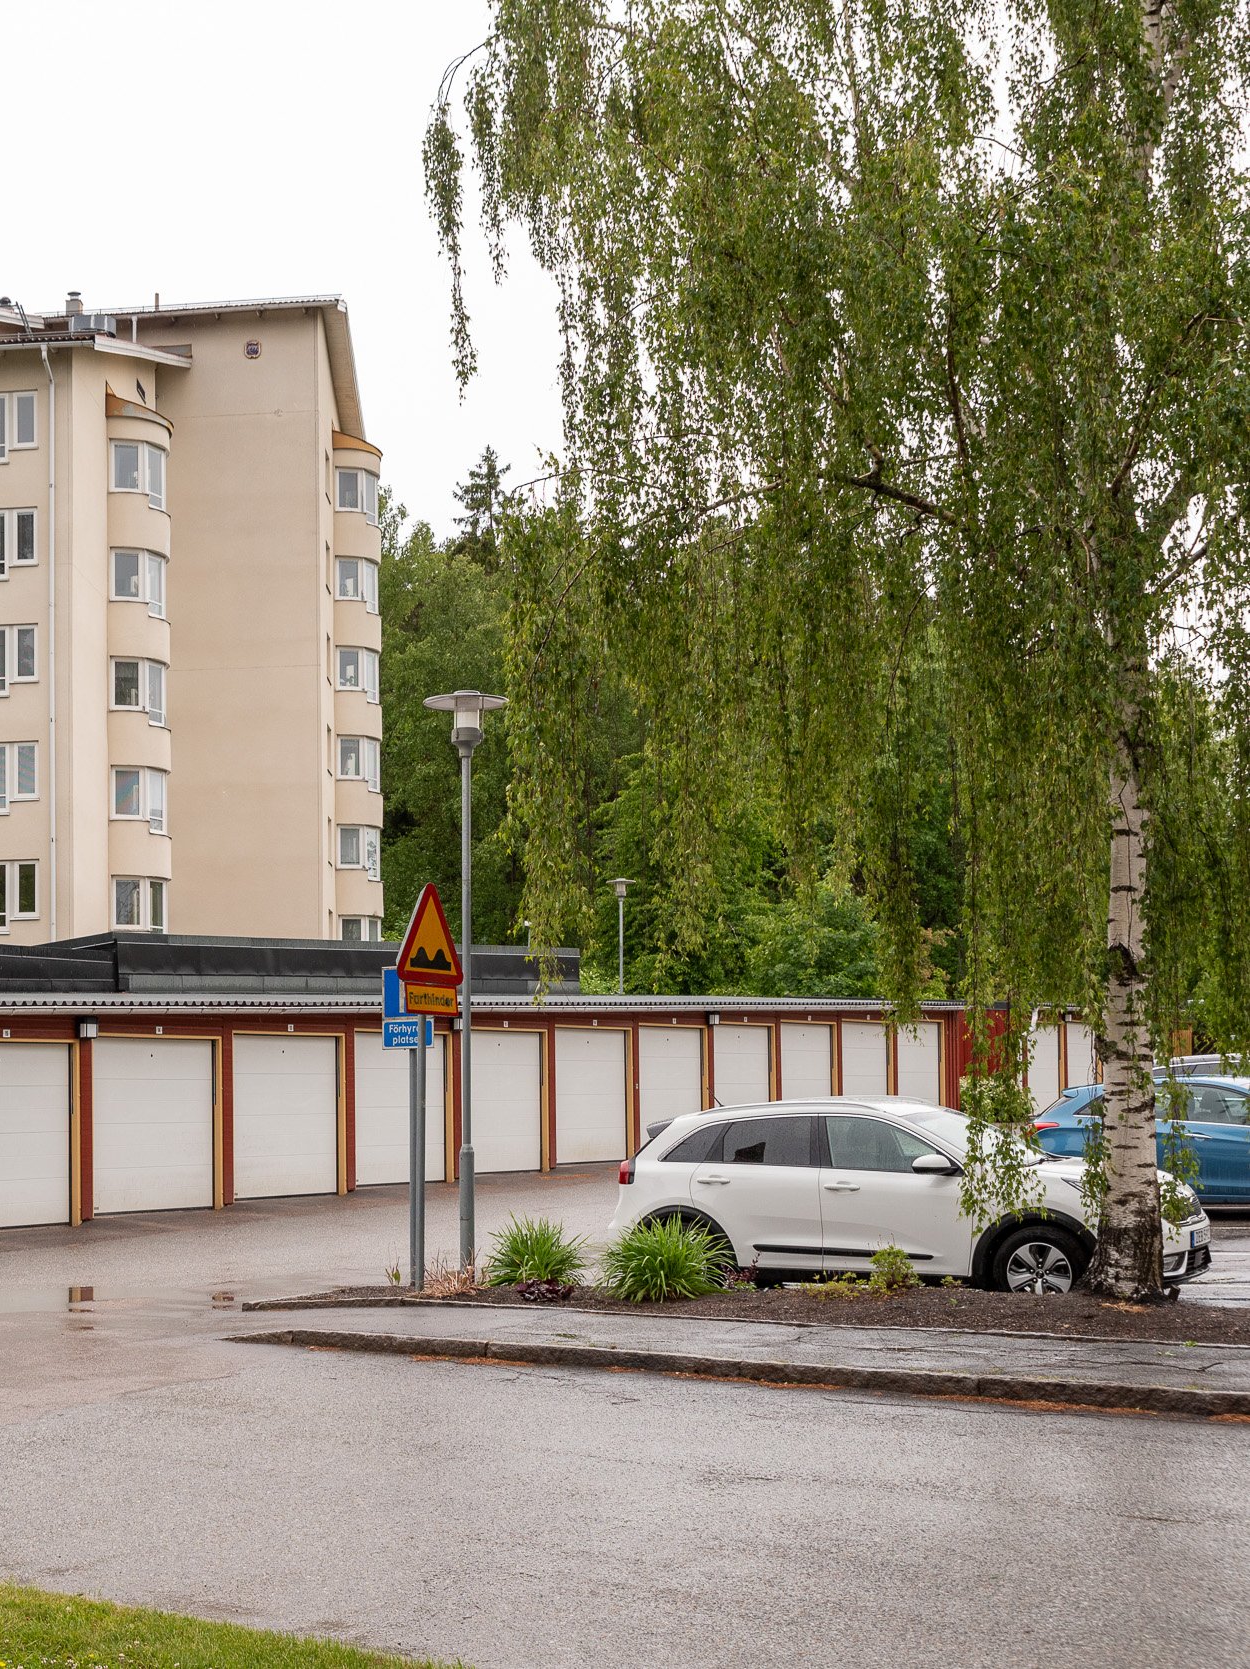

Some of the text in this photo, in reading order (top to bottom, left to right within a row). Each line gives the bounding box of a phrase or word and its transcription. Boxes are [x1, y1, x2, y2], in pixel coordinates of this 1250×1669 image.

[409, 992, 454, 1007] Farthinder
[389, 1023, 418, 1034] Förhyr
[393, 1035, 418, 1046] platse
